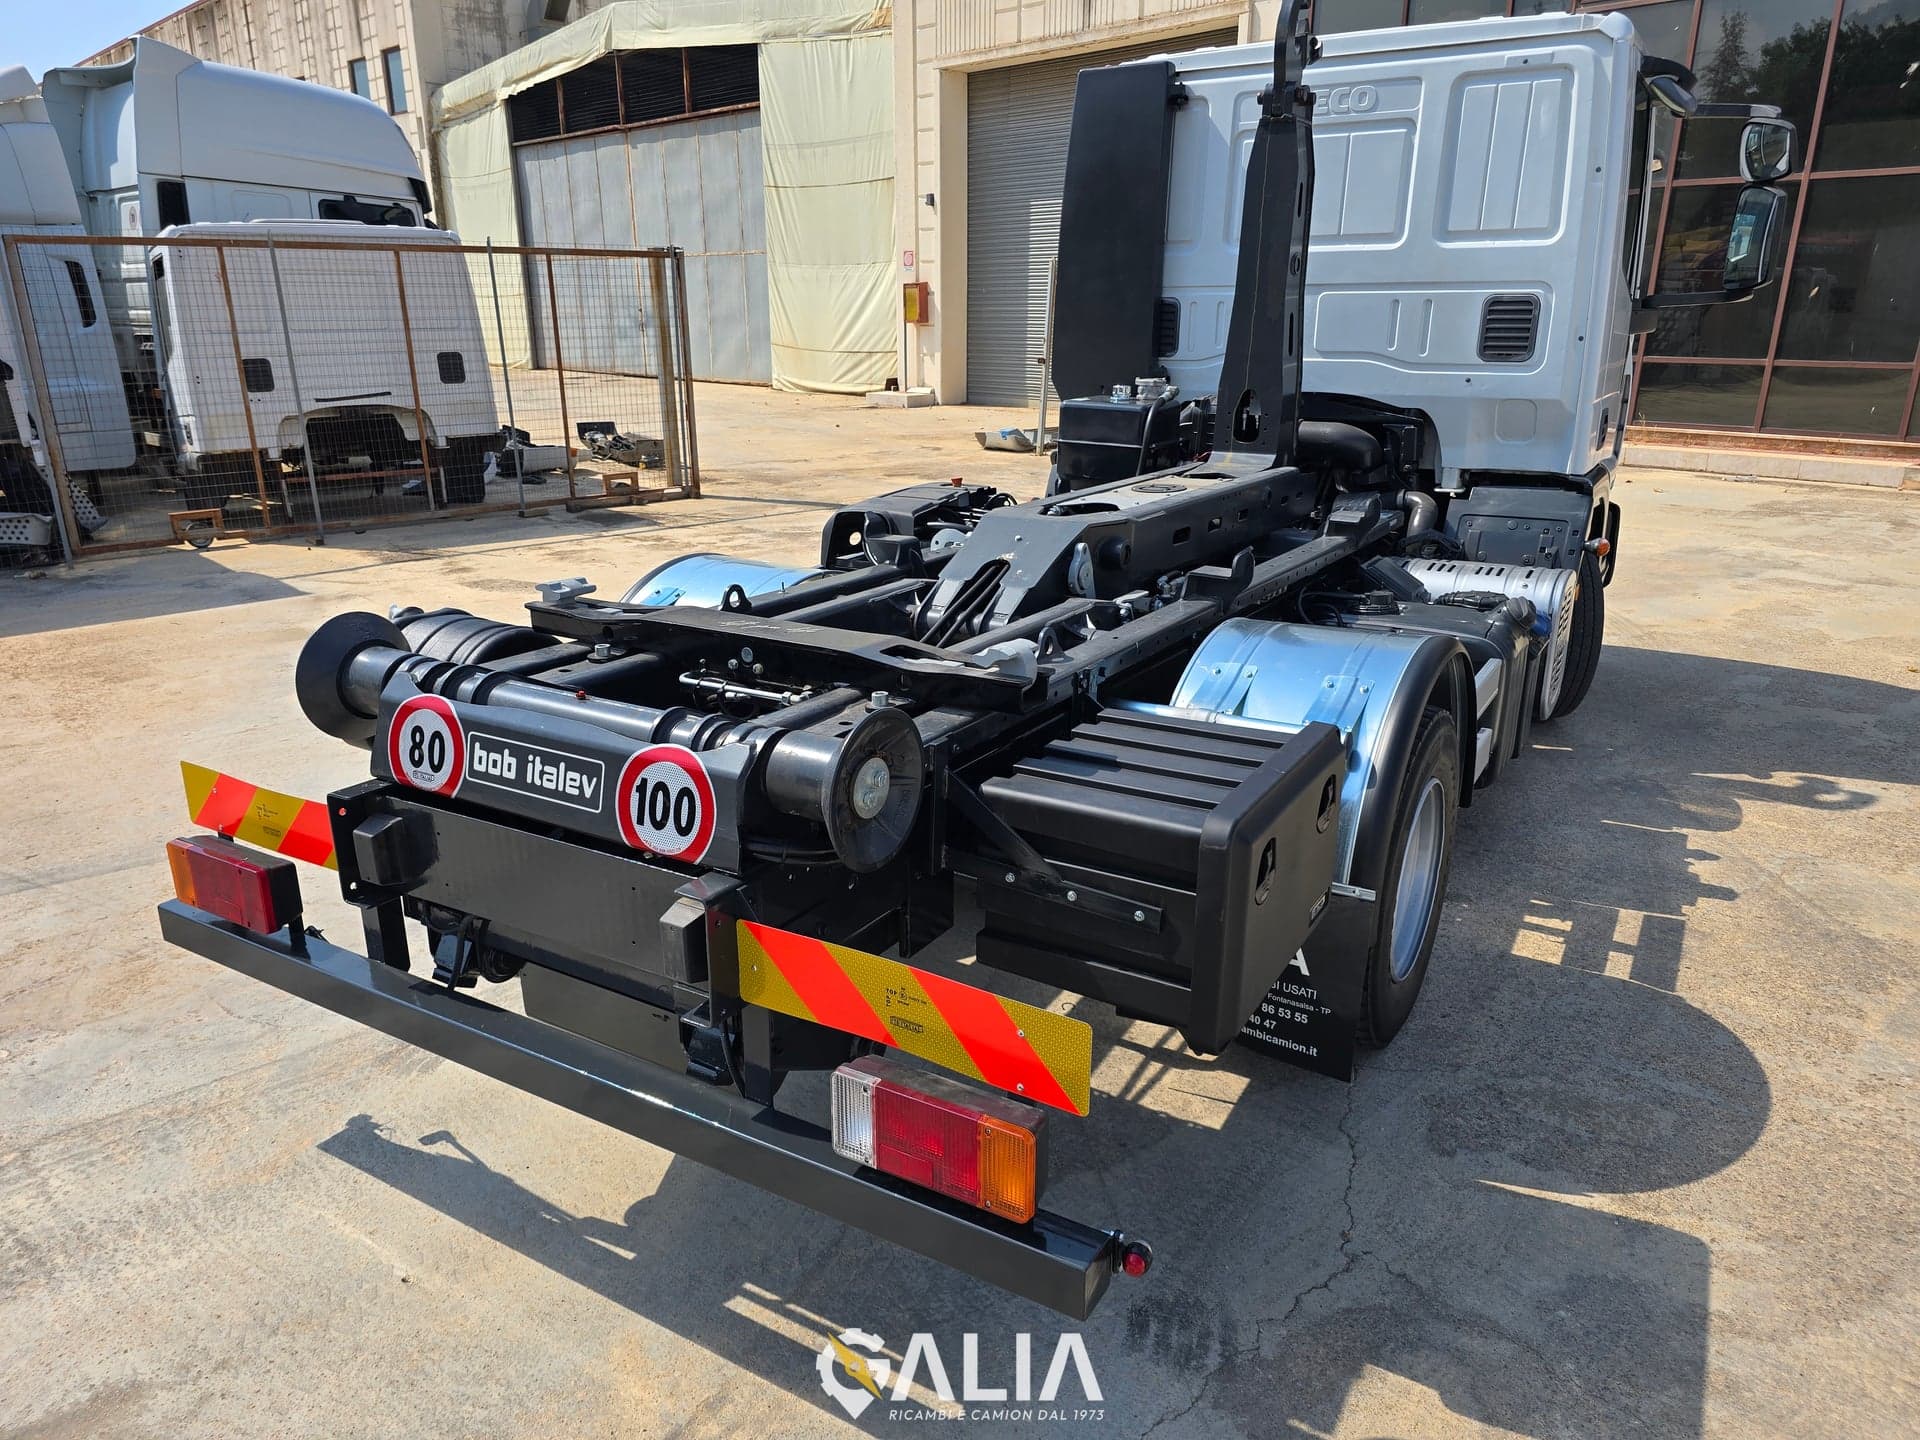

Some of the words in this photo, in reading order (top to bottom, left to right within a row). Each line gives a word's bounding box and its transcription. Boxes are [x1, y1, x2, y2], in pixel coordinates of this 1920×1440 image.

[408, 725, 446, 773] 80
[473, 742, 517, 780] bob
[526, 755, 597, 799] italev
[635, 777, 697, 838] 100
[1283, 983, 1317, 1000] USATI
[1262, 1003, 1275, 1014] 86
[1278, 1008, 1291, 1019] 53
[1294, 1014, 1308, 1024] 55
[1321, 1007, 1331, 1015] TP
[1264, 1019, 1277, 1030] 47
